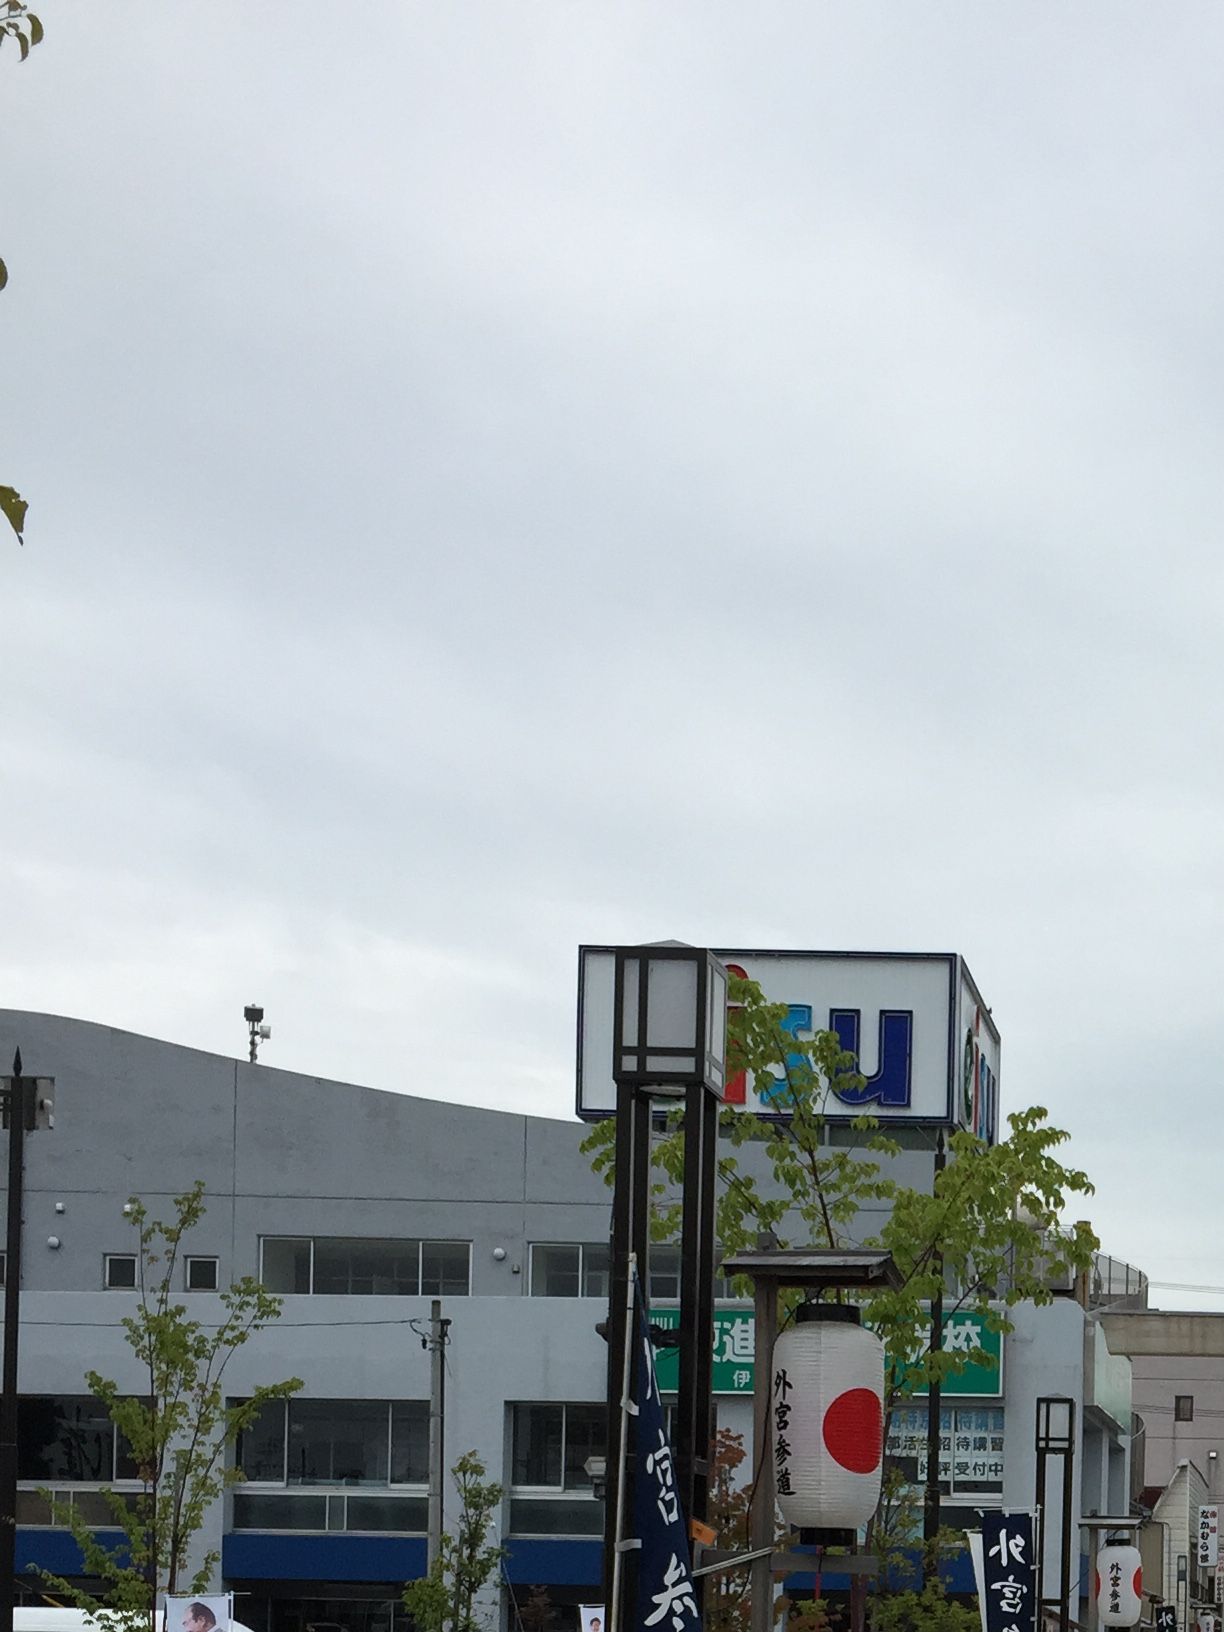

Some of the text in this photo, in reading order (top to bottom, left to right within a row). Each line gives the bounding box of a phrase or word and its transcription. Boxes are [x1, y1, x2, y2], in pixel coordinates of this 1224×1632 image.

[774, 1368, 797, 1496] 外宮参道
[1109, 1562, 1122, 1614] 外宮参道
